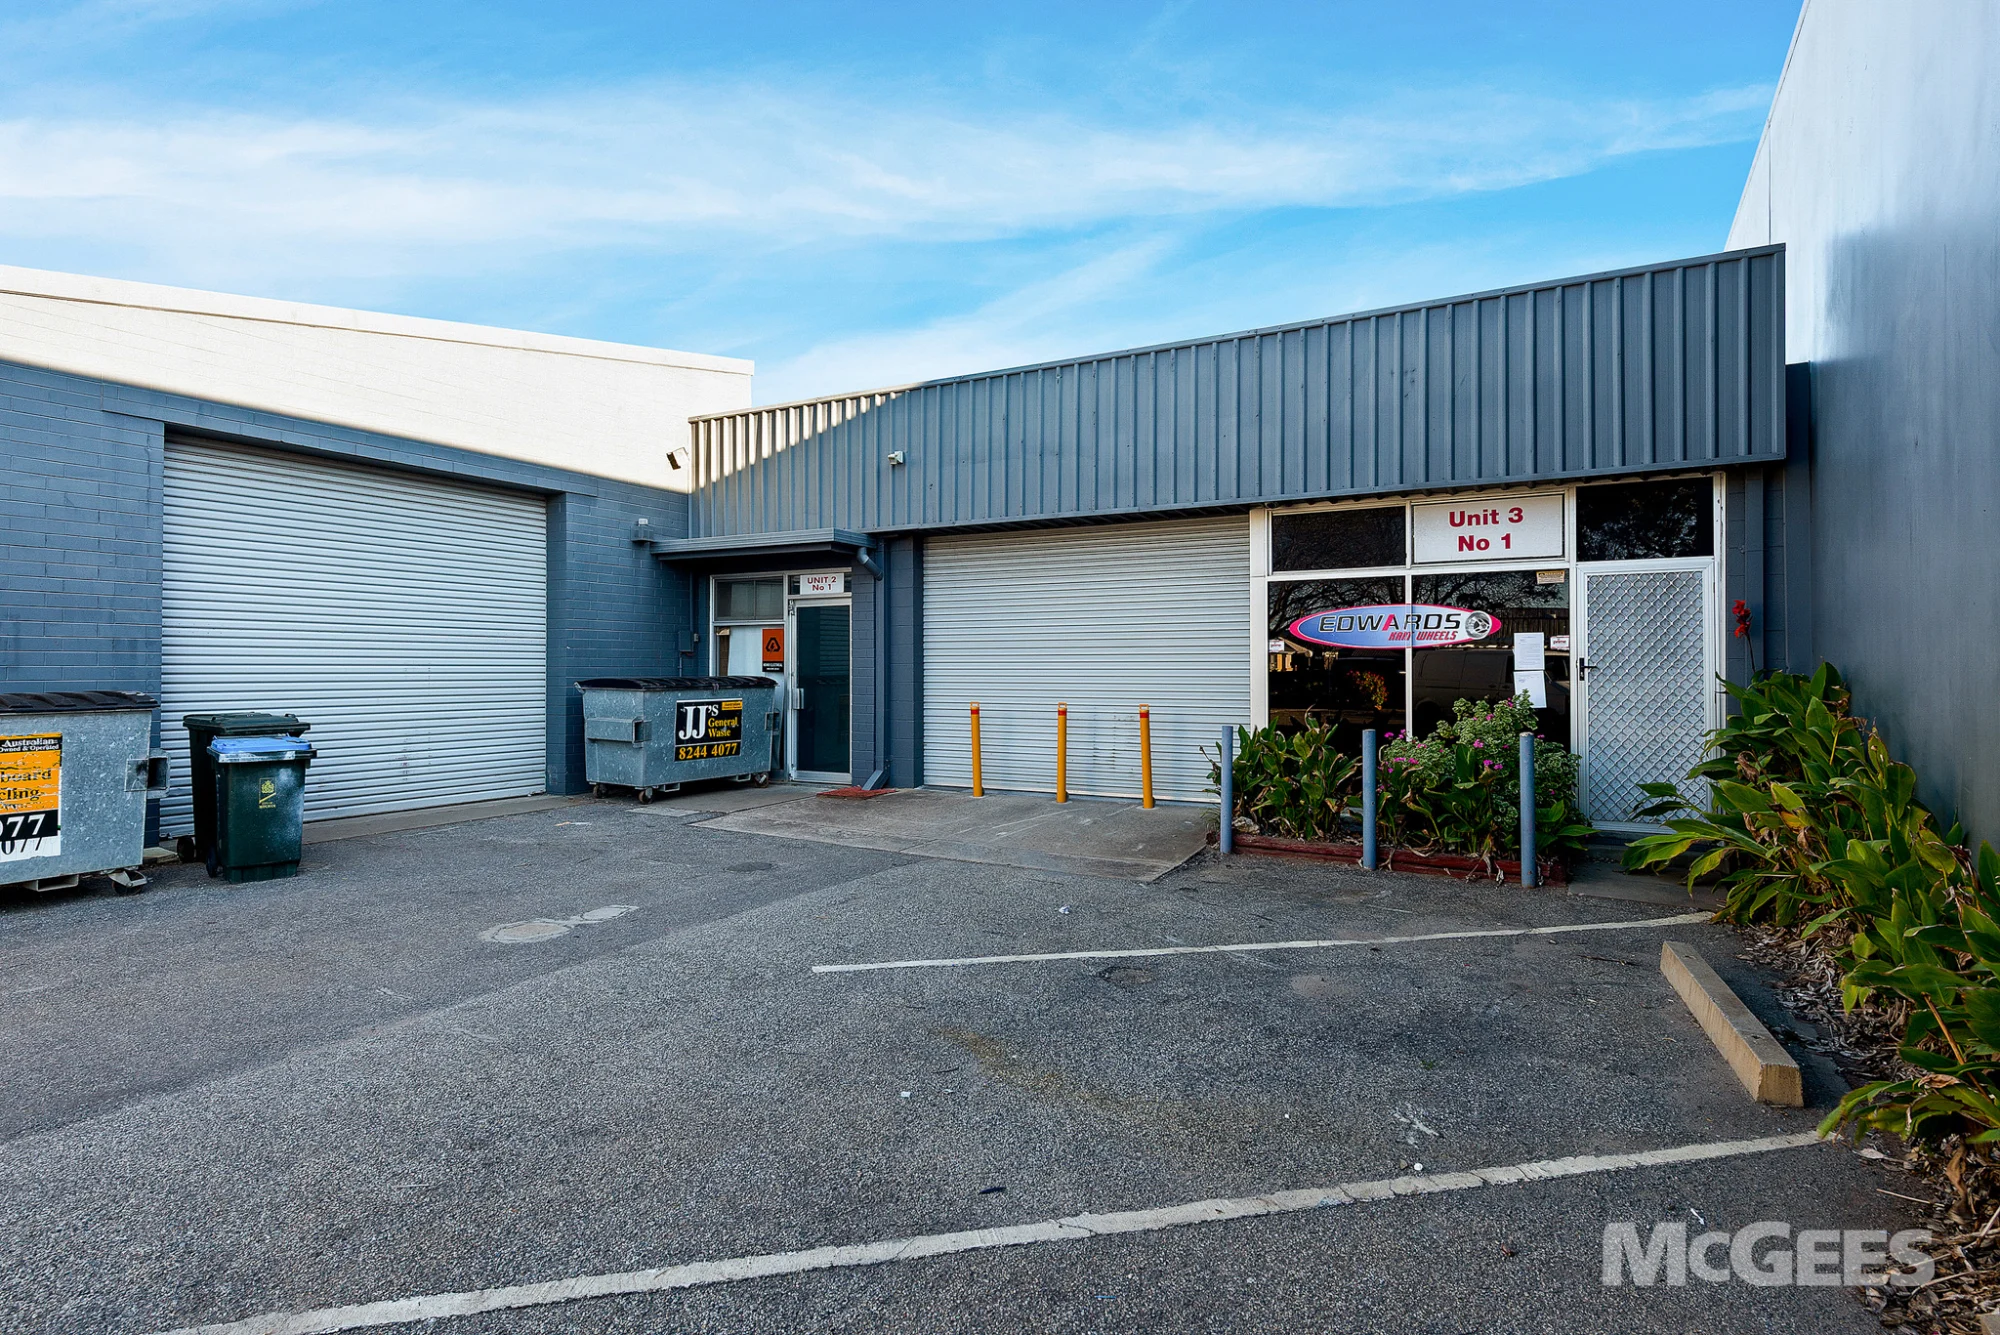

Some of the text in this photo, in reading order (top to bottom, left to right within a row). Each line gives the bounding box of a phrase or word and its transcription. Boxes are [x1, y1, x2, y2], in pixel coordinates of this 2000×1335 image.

[1449, 507, 1523, 527] Unit 3
[1458, 533, 1511, 552] No 1
[807, 576, 828, 584] UNIT
[1319, 613, 1461, 632] EDWARDS
[1388, 631, 1458, 641] KART WHEELS
[708, 717, 738, 728] General
[708, 728, 731, 738] Waste
[2, 738, 54, 747] Australian
[679, 743, 738, 760] 8244 4077
[0, 814, 45, 837] 77
